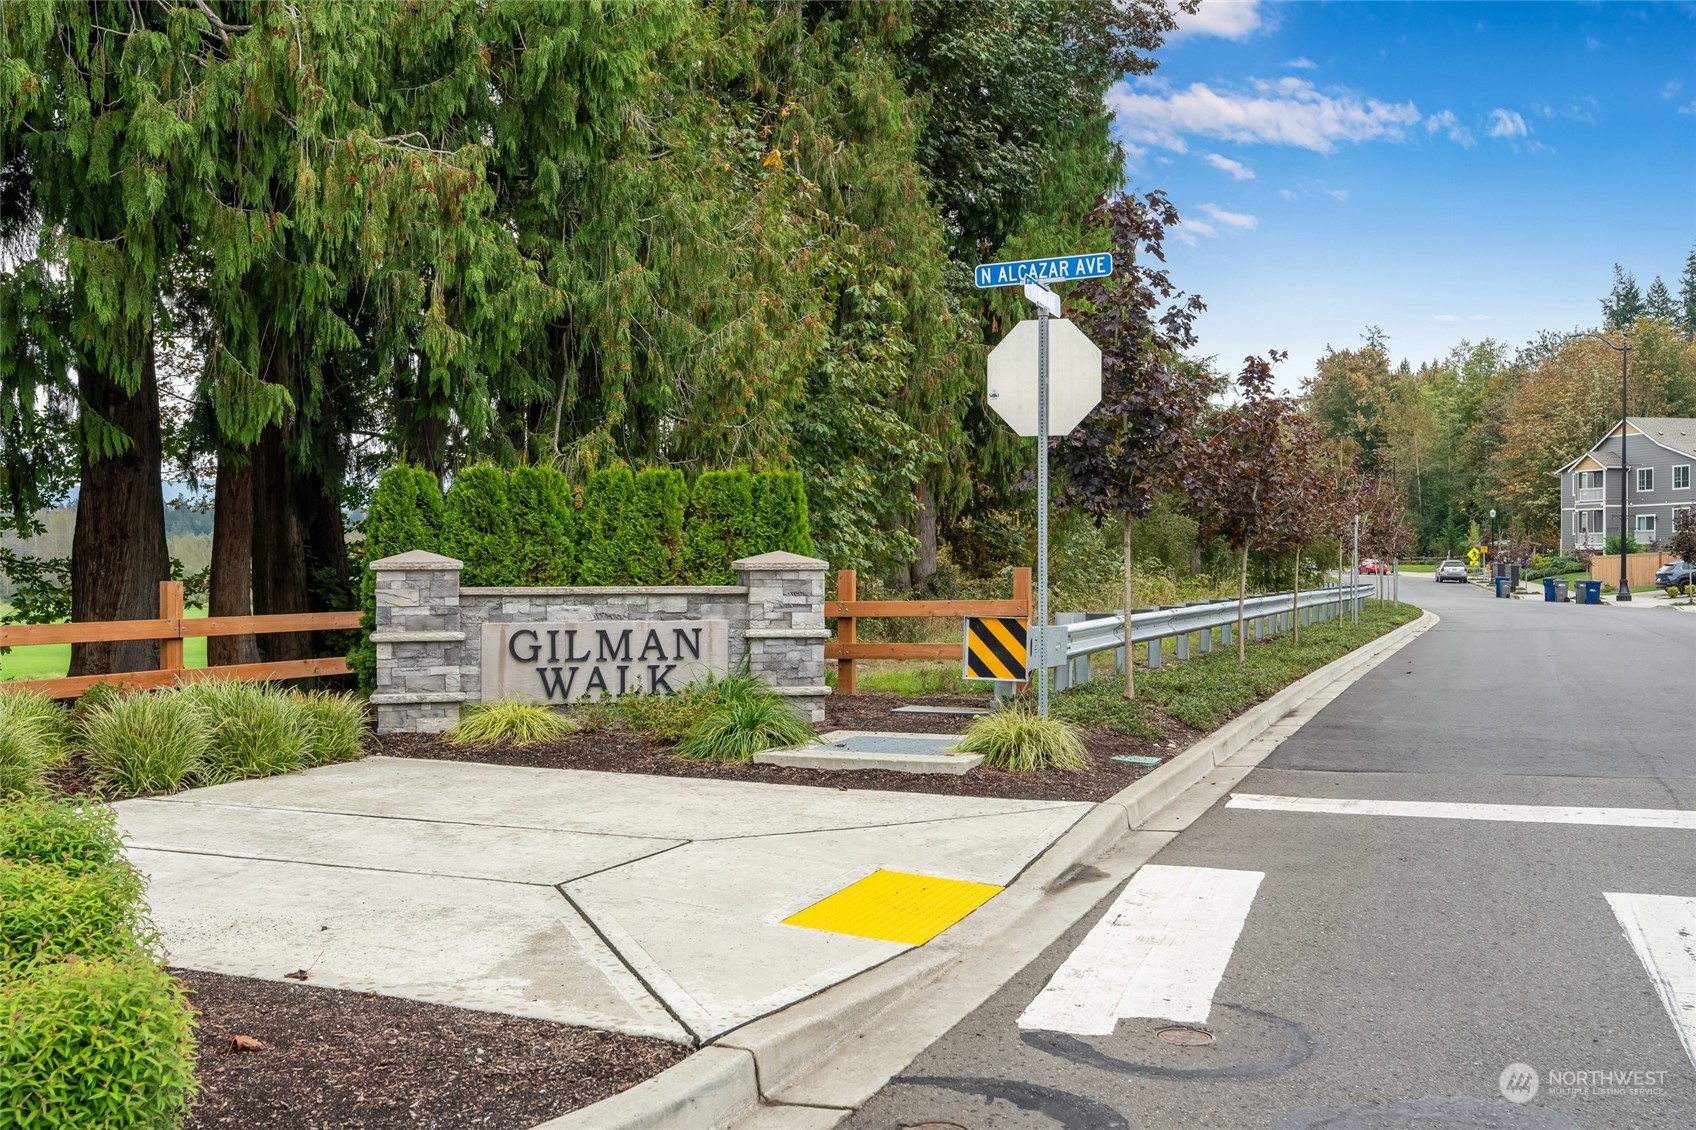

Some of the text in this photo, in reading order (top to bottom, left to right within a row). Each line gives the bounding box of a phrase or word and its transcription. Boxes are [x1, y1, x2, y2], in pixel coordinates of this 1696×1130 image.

[981, 256, 1107, 285] N ALCAZAR AVE
[508, 627, 703, 663] GILMAN
[536, 664, 678, 700] WALK
